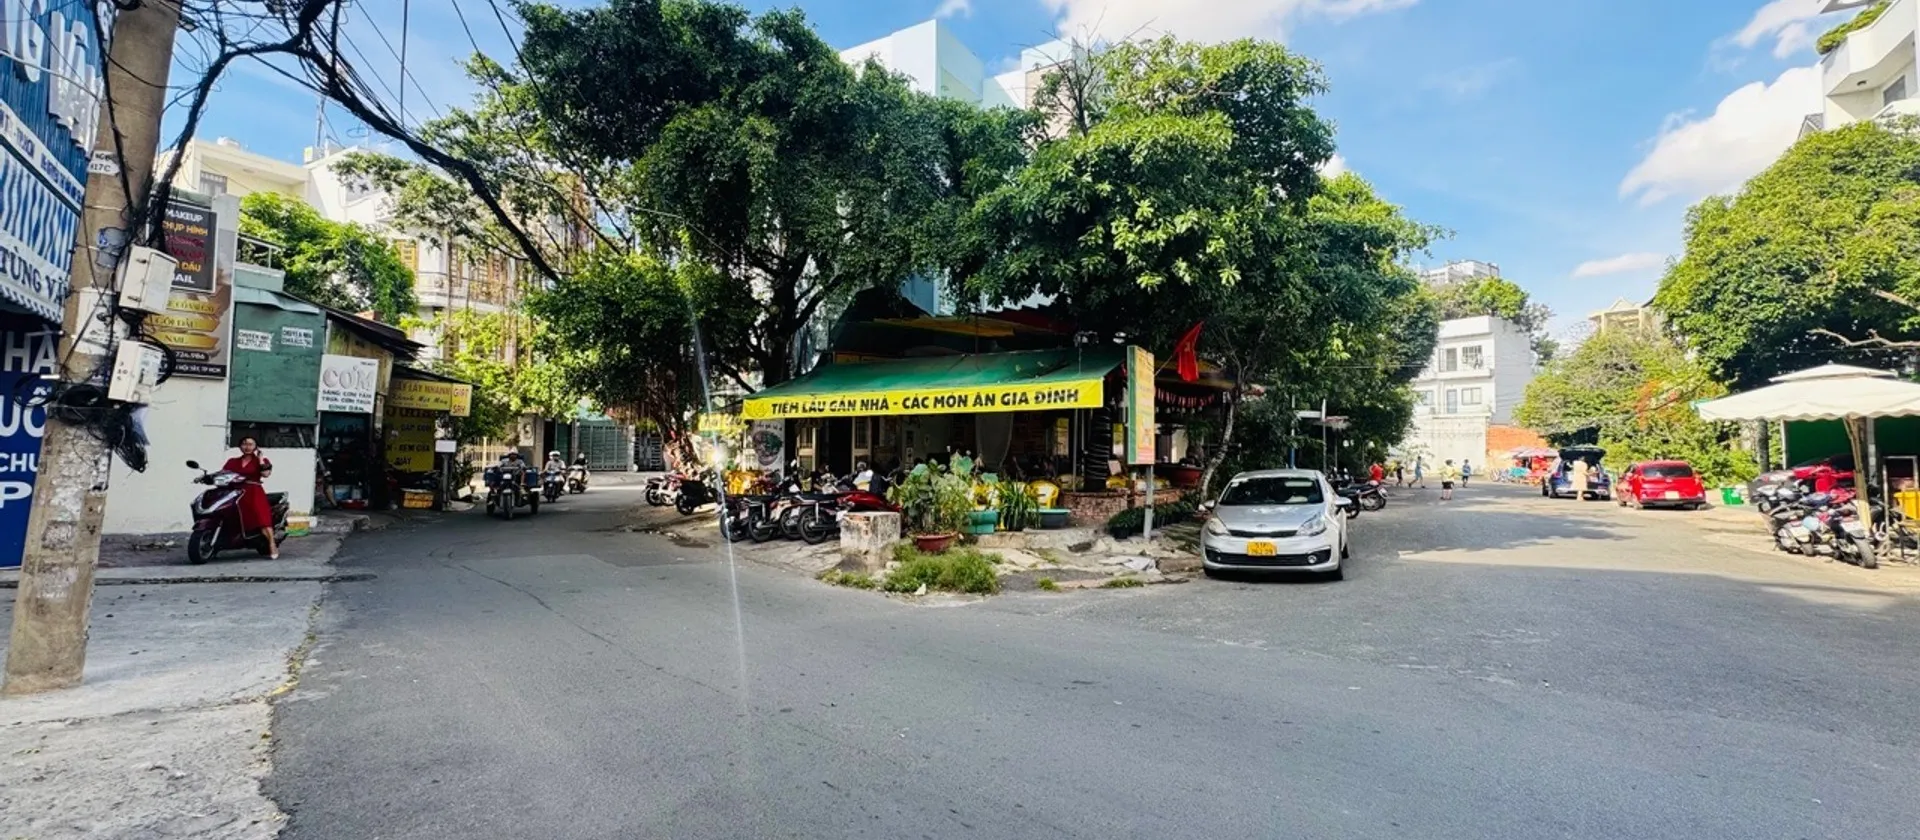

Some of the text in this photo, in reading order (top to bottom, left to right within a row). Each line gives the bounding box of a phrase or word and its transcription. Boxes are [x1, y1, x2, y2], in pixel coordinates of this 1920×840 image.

[173, 274, 195, 284] AIL
[322, 365, 375, 391] CƠM
[859, 397, 889, 411] NHÀ
[902, 393, 930, 410] CÁC
[932, 391, 968, 409] MÓN
[972, 391, 996, 408] ĂN
[1000, 390, 1030, 406] GIA
[1033, 387, 1080, 404] ĐÌNH
